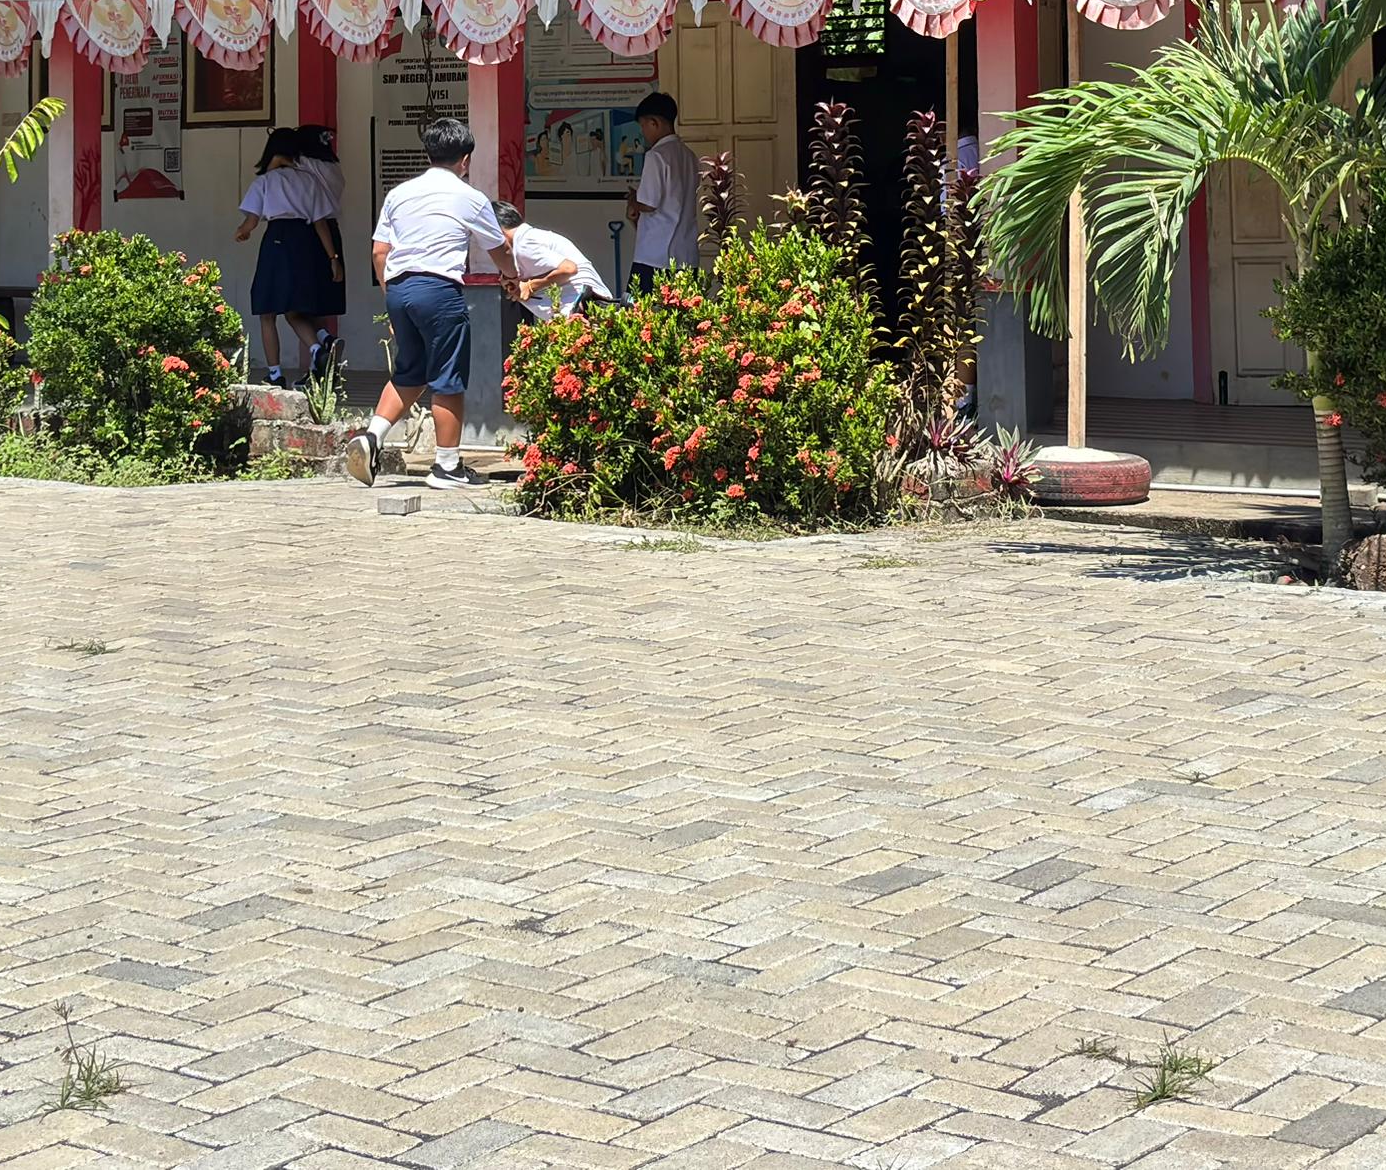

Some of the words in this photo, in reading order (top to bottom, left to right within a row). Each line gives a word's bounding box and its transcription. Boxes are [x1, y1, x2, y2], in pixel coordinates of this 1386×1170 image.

[382, 73, 399, 84] SMP
[434, 71, 468, 83] AMURAN
[431, 89, 449, 100] VISI
